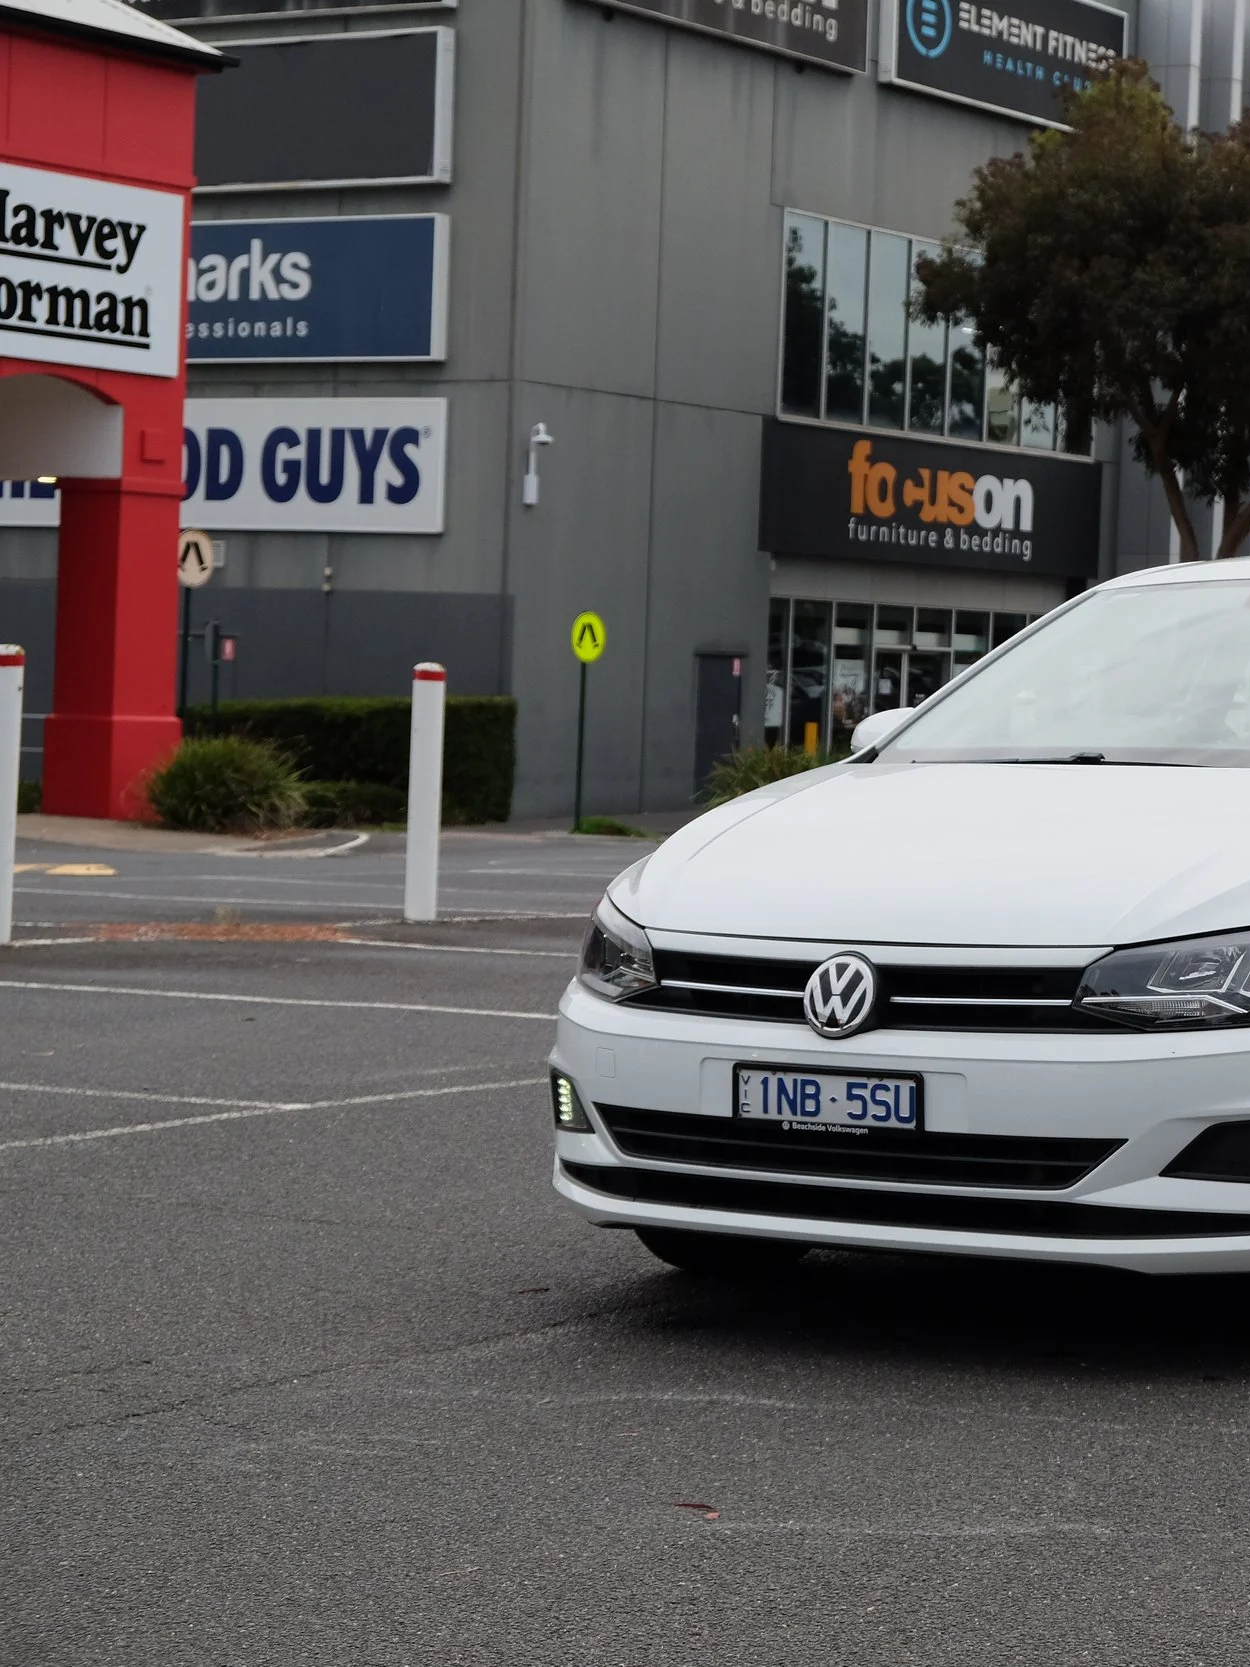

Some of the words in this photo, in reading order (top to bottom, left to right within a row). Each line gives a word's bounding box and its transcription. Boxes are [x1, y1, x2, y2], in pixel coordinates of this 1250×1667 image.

[958, 1, 1046, 51] ELEMENT
[983, 50, 1045, 81] HEALTH
[0, 189, 147, 274] arvey
[848, 517, 939, 548] furniture
[943, 527, 955, 549] &
[960, 528, 1033, 561] bedding
[740, 1074, 751, 1114] VIC
[792, 1121, 826, 1132] Beachside
[827, 1124, 869, 1136] Volkswagen
